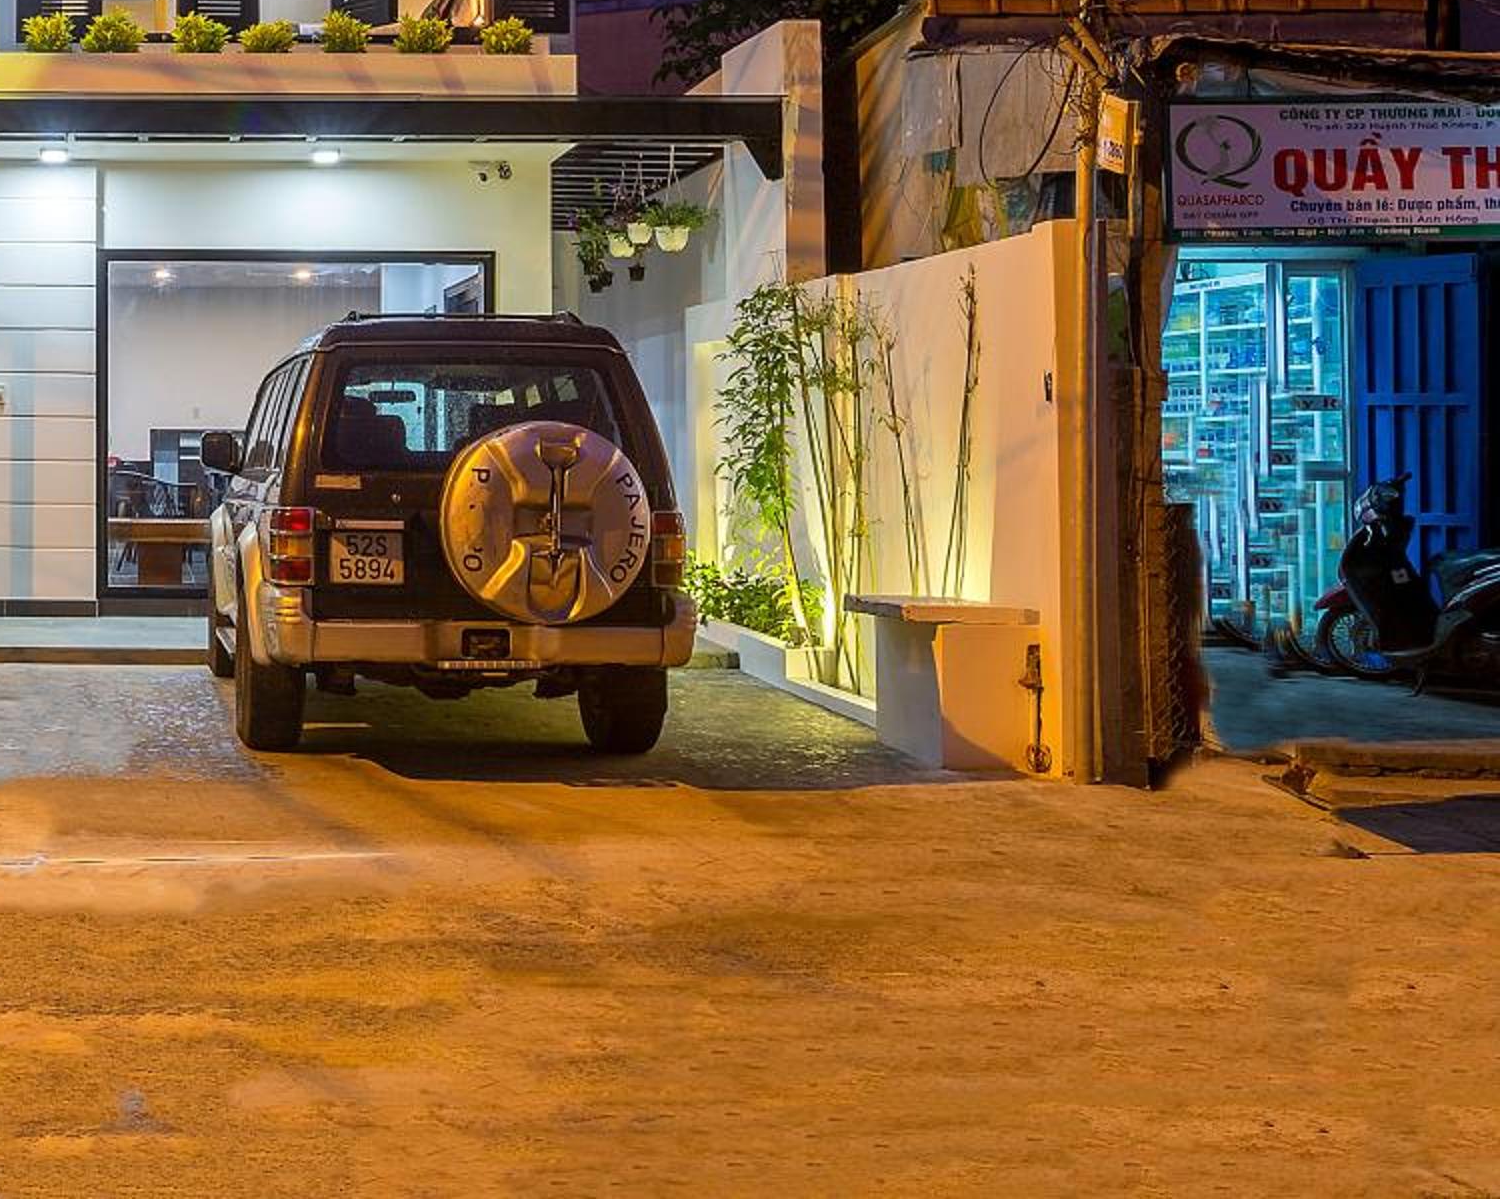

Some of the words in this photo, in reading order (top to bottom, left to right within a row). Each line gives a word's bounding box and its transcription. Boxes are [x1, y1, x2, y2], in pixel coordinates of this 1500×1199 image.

[1325, 108, 1341, 119] TY
[1345, 108, 1365, 119] CP
[1273, 132, 1423, 197] QUẦY
[610, 472, 645, 584] PAJERO
[347, 535, 388, 557] 52S
[340, 558, 395, 580] 5894
